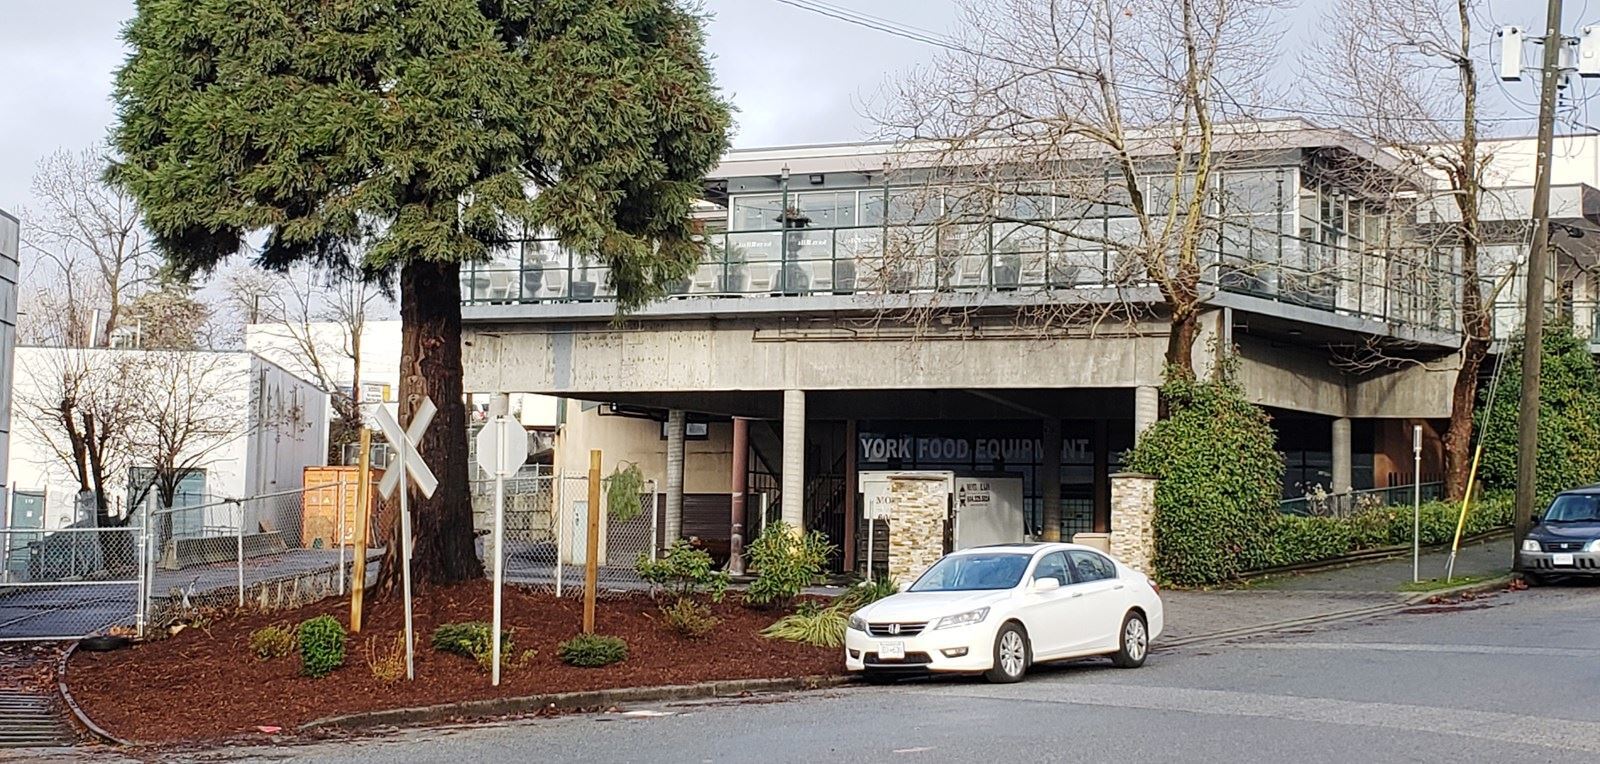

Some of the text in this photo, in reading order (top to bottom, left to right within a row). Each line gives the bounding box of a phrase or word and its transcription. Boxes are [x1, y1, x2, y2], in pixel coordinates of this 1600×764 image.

[860, 438, 1090, 459] YORK FOOD EQUIPMNT
